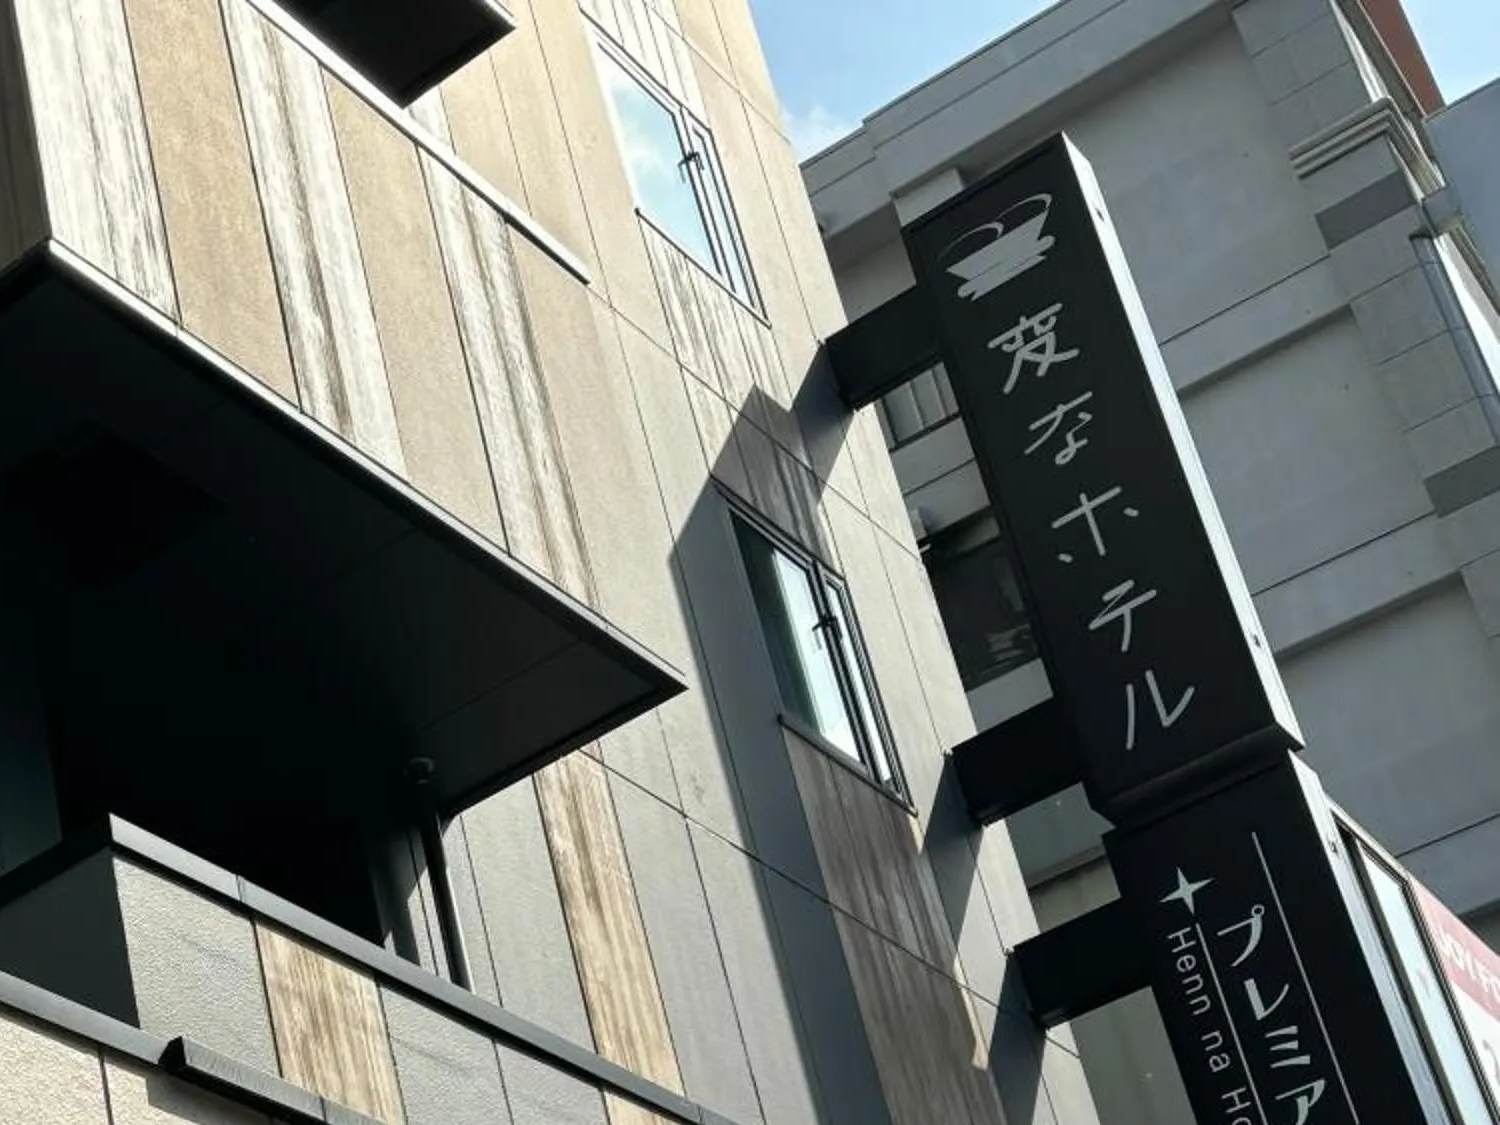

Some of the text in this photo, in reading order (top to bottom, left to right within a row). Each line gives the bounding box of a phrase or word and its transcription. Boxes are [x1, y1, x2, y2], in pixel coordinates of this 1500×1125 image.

[988, 303, 1195, 751] 変なホテル
[1167, 925, 1212, 1017] Henn
[1201, 1033, 1232, 1074] na
